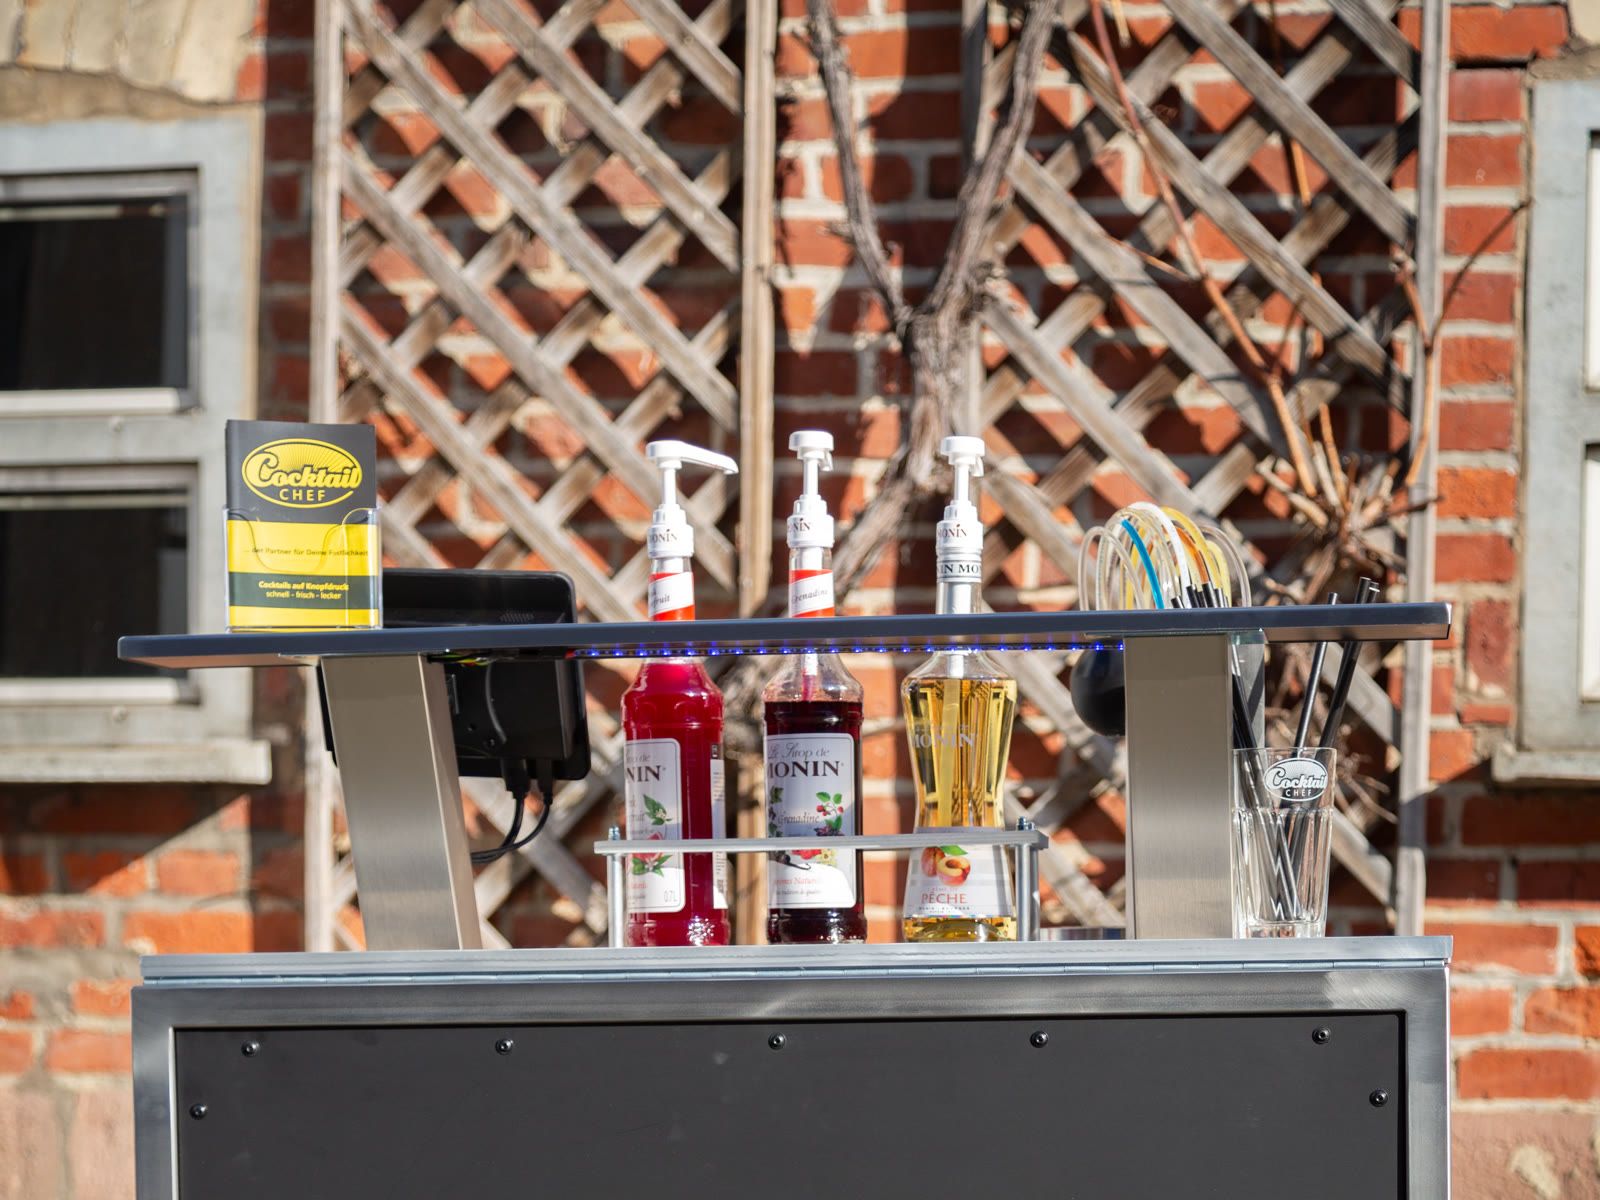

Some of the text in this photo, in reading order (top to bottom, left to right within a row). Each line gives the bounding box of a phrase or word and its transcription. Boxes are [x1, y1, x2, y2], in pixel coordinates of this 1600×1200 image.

[245, 453, 360, 488] Cocktail
[279, 489, 326, 501] CHEF
[258, 580, 350, 592] Cocktails auf Knopfdruck
[1265, 767, 1327, 791] Cocktail
[1285, 789, 1312, 797] CHEF
